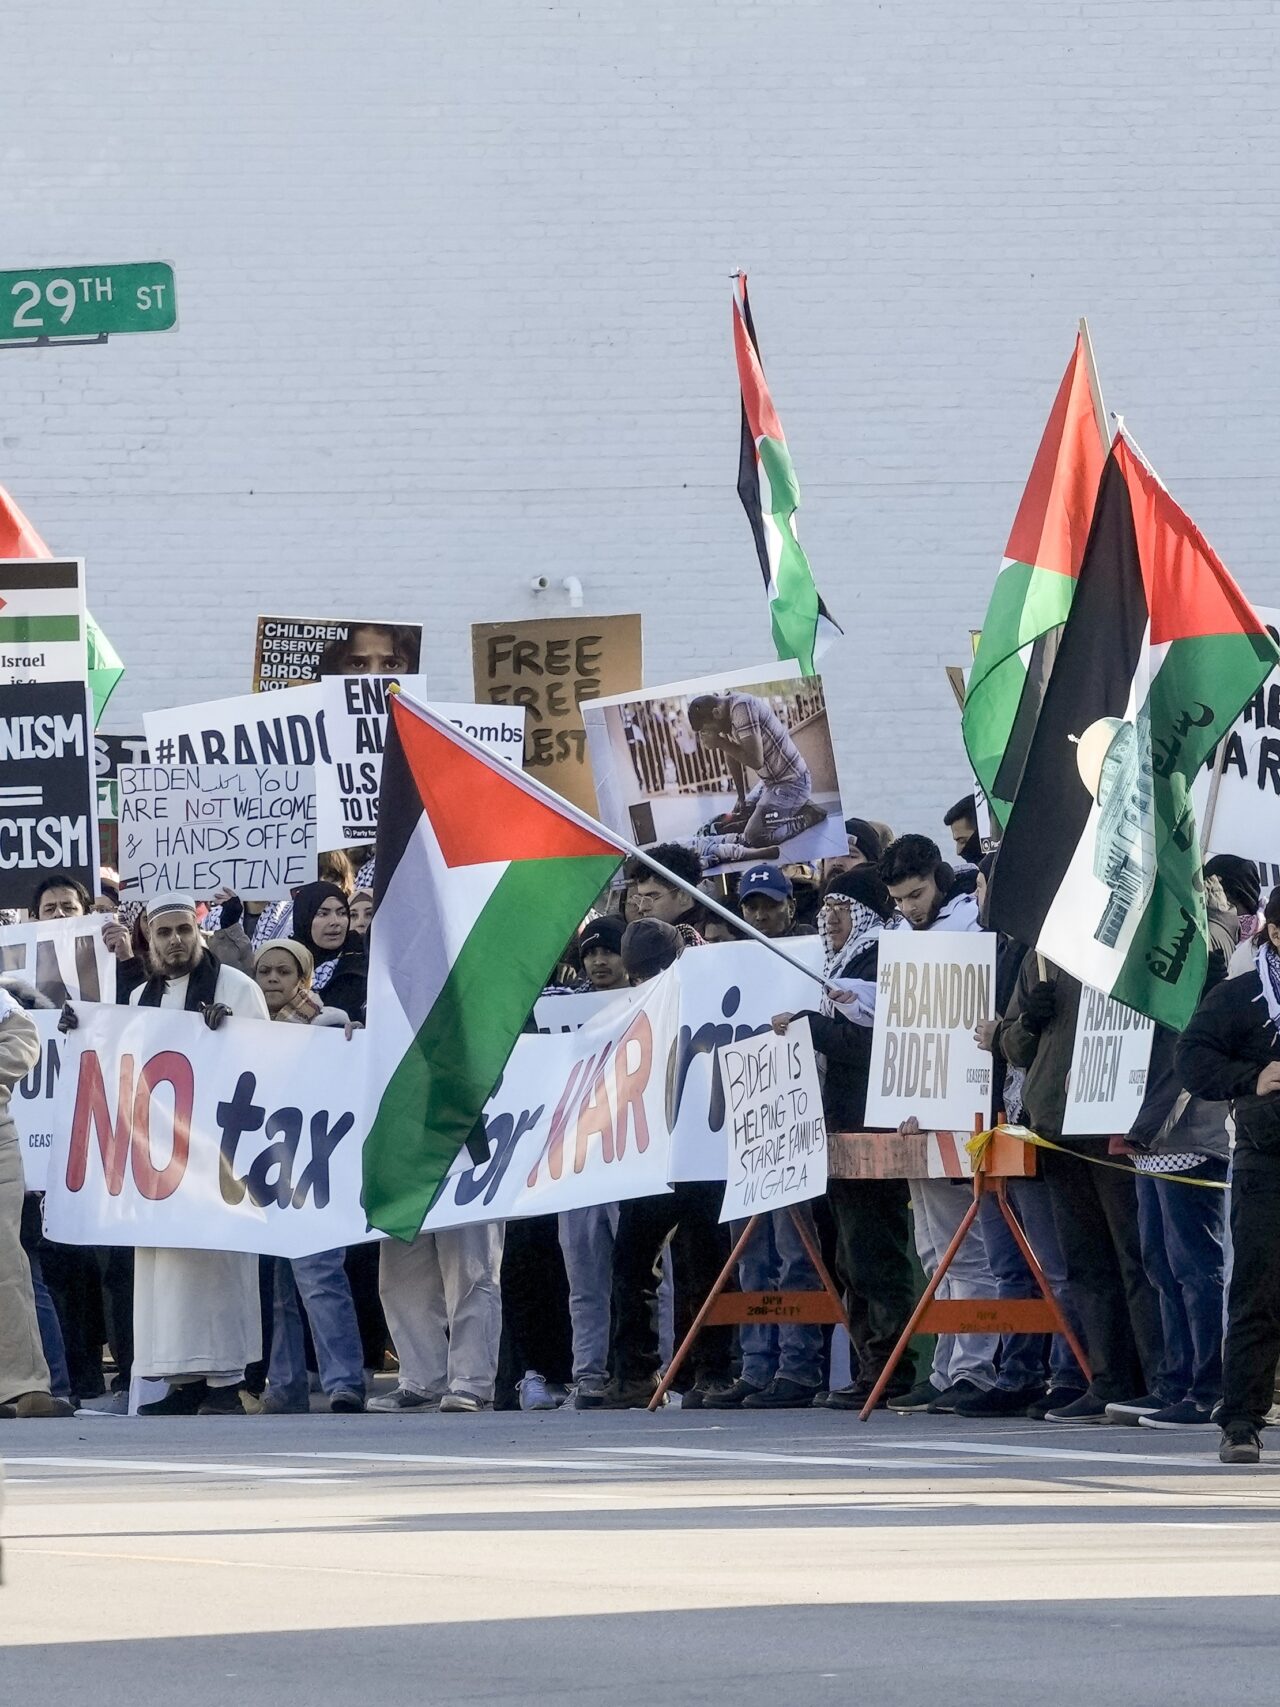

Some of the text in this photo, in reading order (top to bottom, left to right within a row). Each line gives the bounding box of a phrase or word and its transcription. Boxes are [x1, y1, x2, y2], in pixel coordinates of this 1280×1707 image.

[11, 277, 166, 328] 29TH ST
[263, 639, 325, 652] DESERVE
[264, 623, 349, 641] CHILDREN
[1, 653, 46, 668] Israel
[260, 664, 318, 680] BIRDS,
[262, 652, 320, 666] TO HEAR
[487, 634, 603, 679] FREE
[259, 681, 289, 692] NOT
[155, 709, 333, 765] #ABAND
[120, 766, 200, 795] BIDEN
[121, 797, 168, 823] ARE
[185, 798, 231, 823] NOT
[233, 794, 317, 821] WELCOME
[340, 798, 363, 822] TO
[156, 826, 240, 858] HANDS
[246, 823, 288, 849] OFF
[290, 823, 317, 850] OF
[138, 855, 307, 894] PALESTINE
[879, 962, 991, 1030] #ABANDON
[725, 1041, 801, 1112] BIDEN IS
[880, 1031, 951, 1100] BIDEN
[1074, 1035, 1123, 1104] BIDEN
[65, 1050, 195, 1201] NO
[216, 1071, 355, 1211] tax
[446, 1100, 546, 1210] or
[733, 1087, 808, 1150] HELPING TO
[28, 1134, 53, 1148] CEAS
[735, 1116, 824, 1187] STARVE FAMILIES
[743, 1162, 808, 1207] IN GAZA
